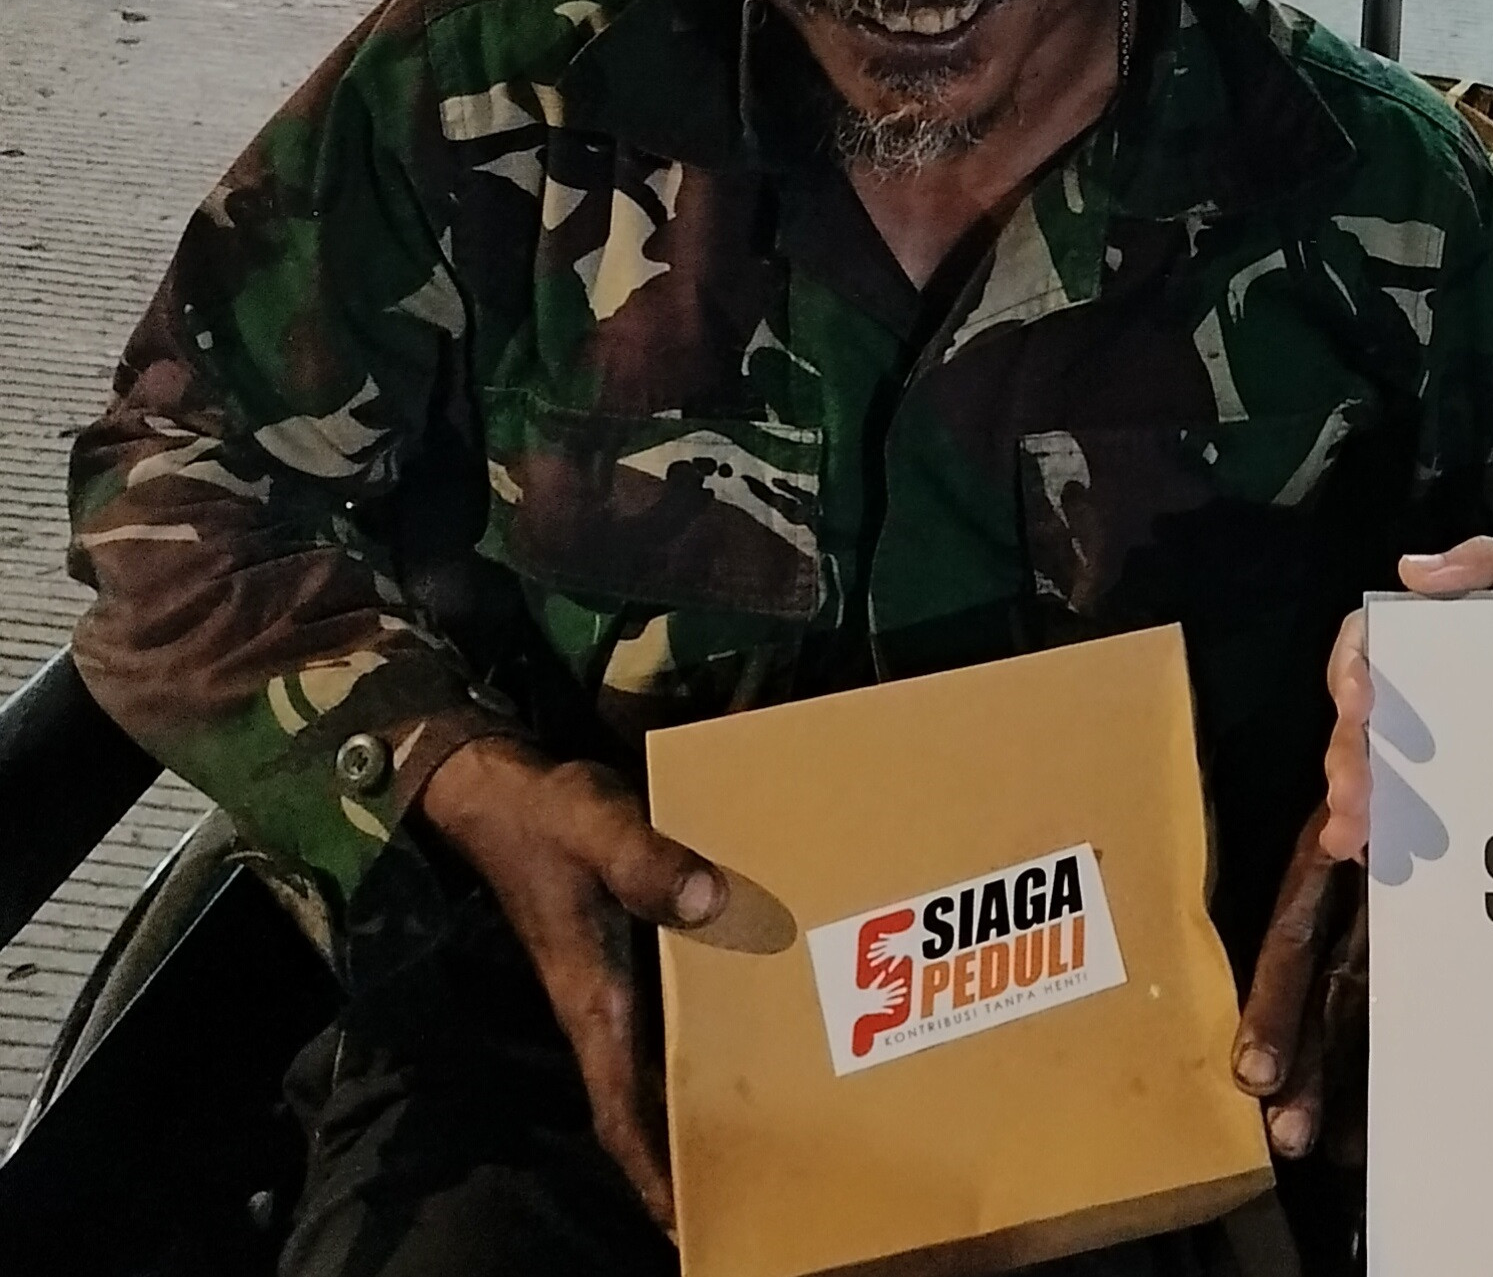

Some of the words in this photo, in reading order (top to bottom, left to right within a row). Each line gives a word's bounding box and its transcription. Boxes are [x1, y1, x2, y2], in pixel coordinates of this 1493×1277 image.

[922, 855, 1083, 960] SIAGA
[884, 1008, 978, 1047] KONTRIBUSI
[985, 991, 1036, 1014] TANPA
[1044, 972, 1088, 994] HENTI
[920, 915, 1085, 1019] PEDULI
